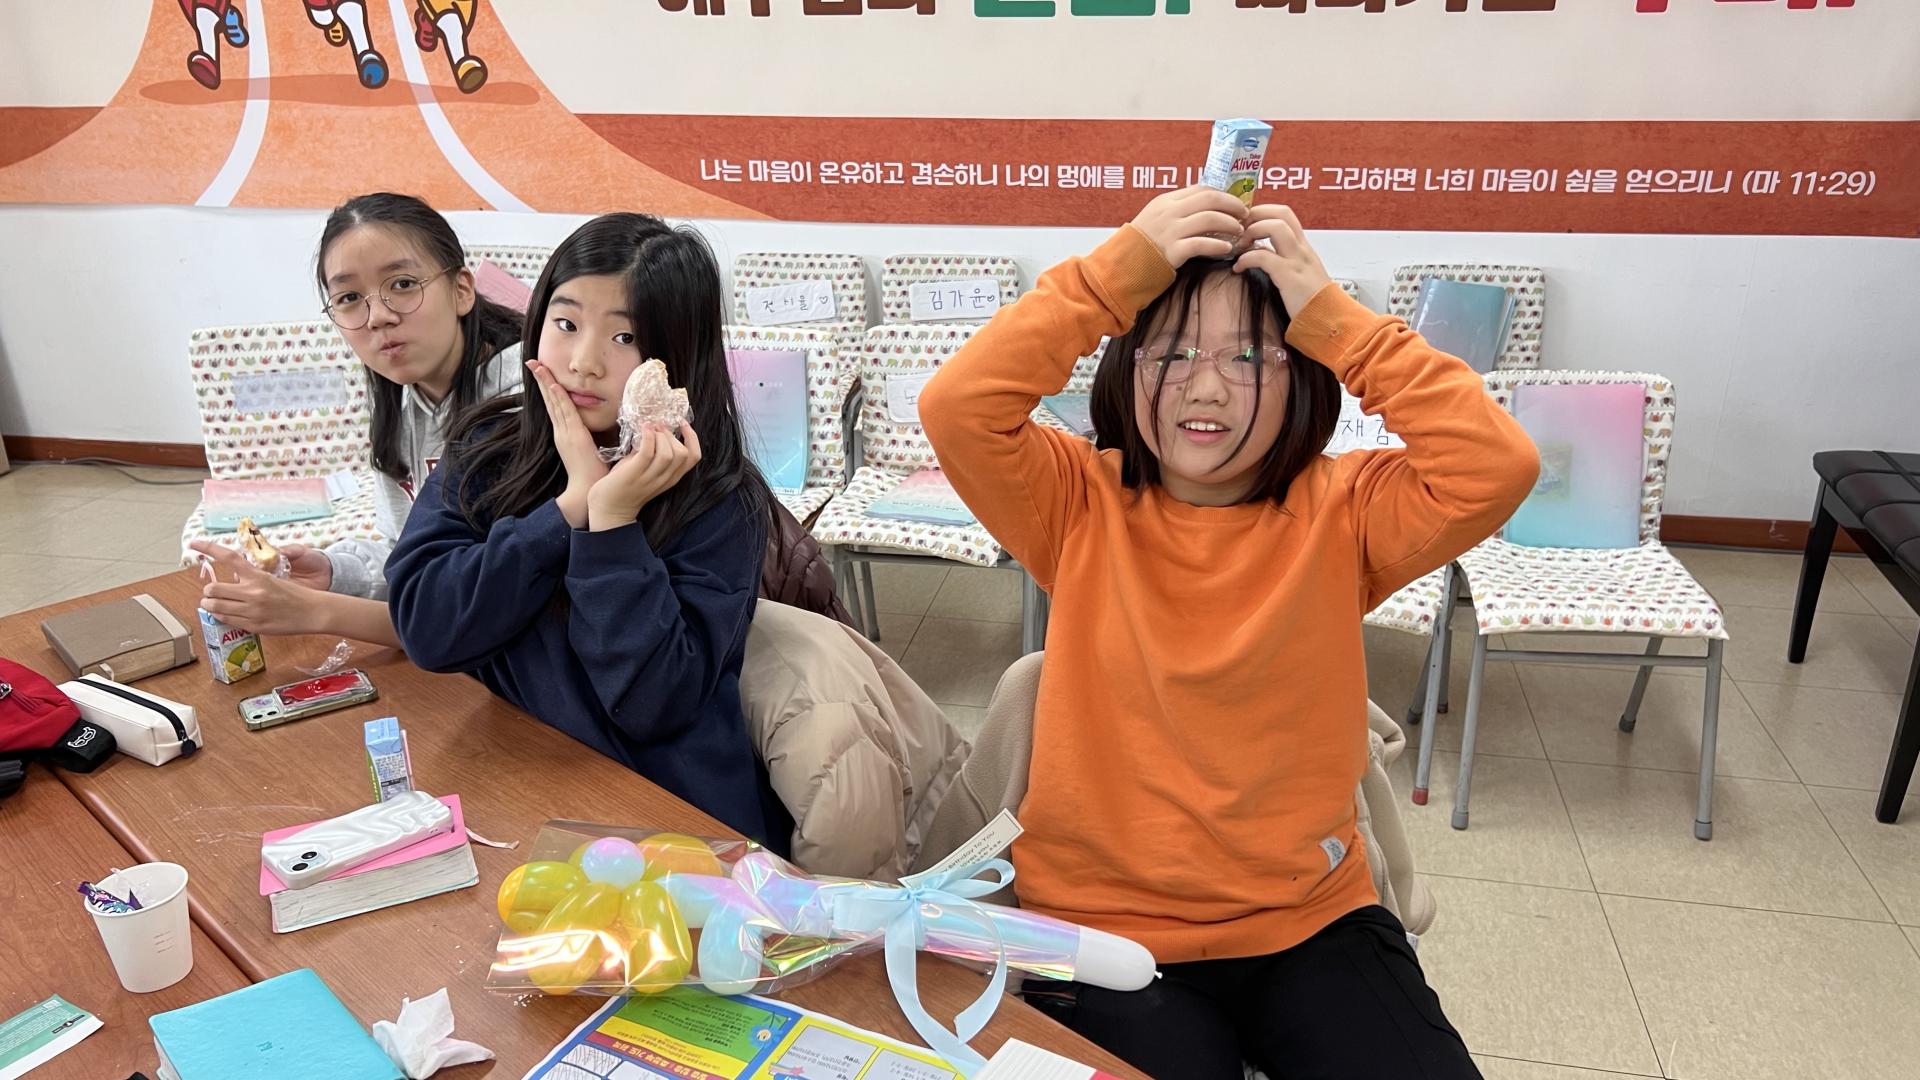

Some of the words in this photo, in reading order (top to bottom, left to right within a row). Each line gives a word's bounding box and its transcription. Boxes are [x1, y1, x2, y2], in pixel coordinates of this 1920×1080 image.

[700, 158, 743, 182] 나는
[748, 159, 812, 183] 마음이
[818, 161, 905, 184] 온유하고
[910, 162, 998, 186] 겸손하니
[1005, 164, 1050, 187] 나의
[1057, 165, 1126, 189] 멍에를
[1132, 166, 1179, 189] 메고
[1257, 166, 1313, 190] 우라
[1319, 167, 1417, 192] 그리하면
[1424, 168, 1475, 192] 너희
[1481, 168, 1558, 193] 마음이
[1565, 169, 1618, 193] 쉼을
[1625, 169, 1733, 194] 얻으리니
[1742, 170, 1781, 195] (마
[1790, 171, 1876, 196] 11:29)
